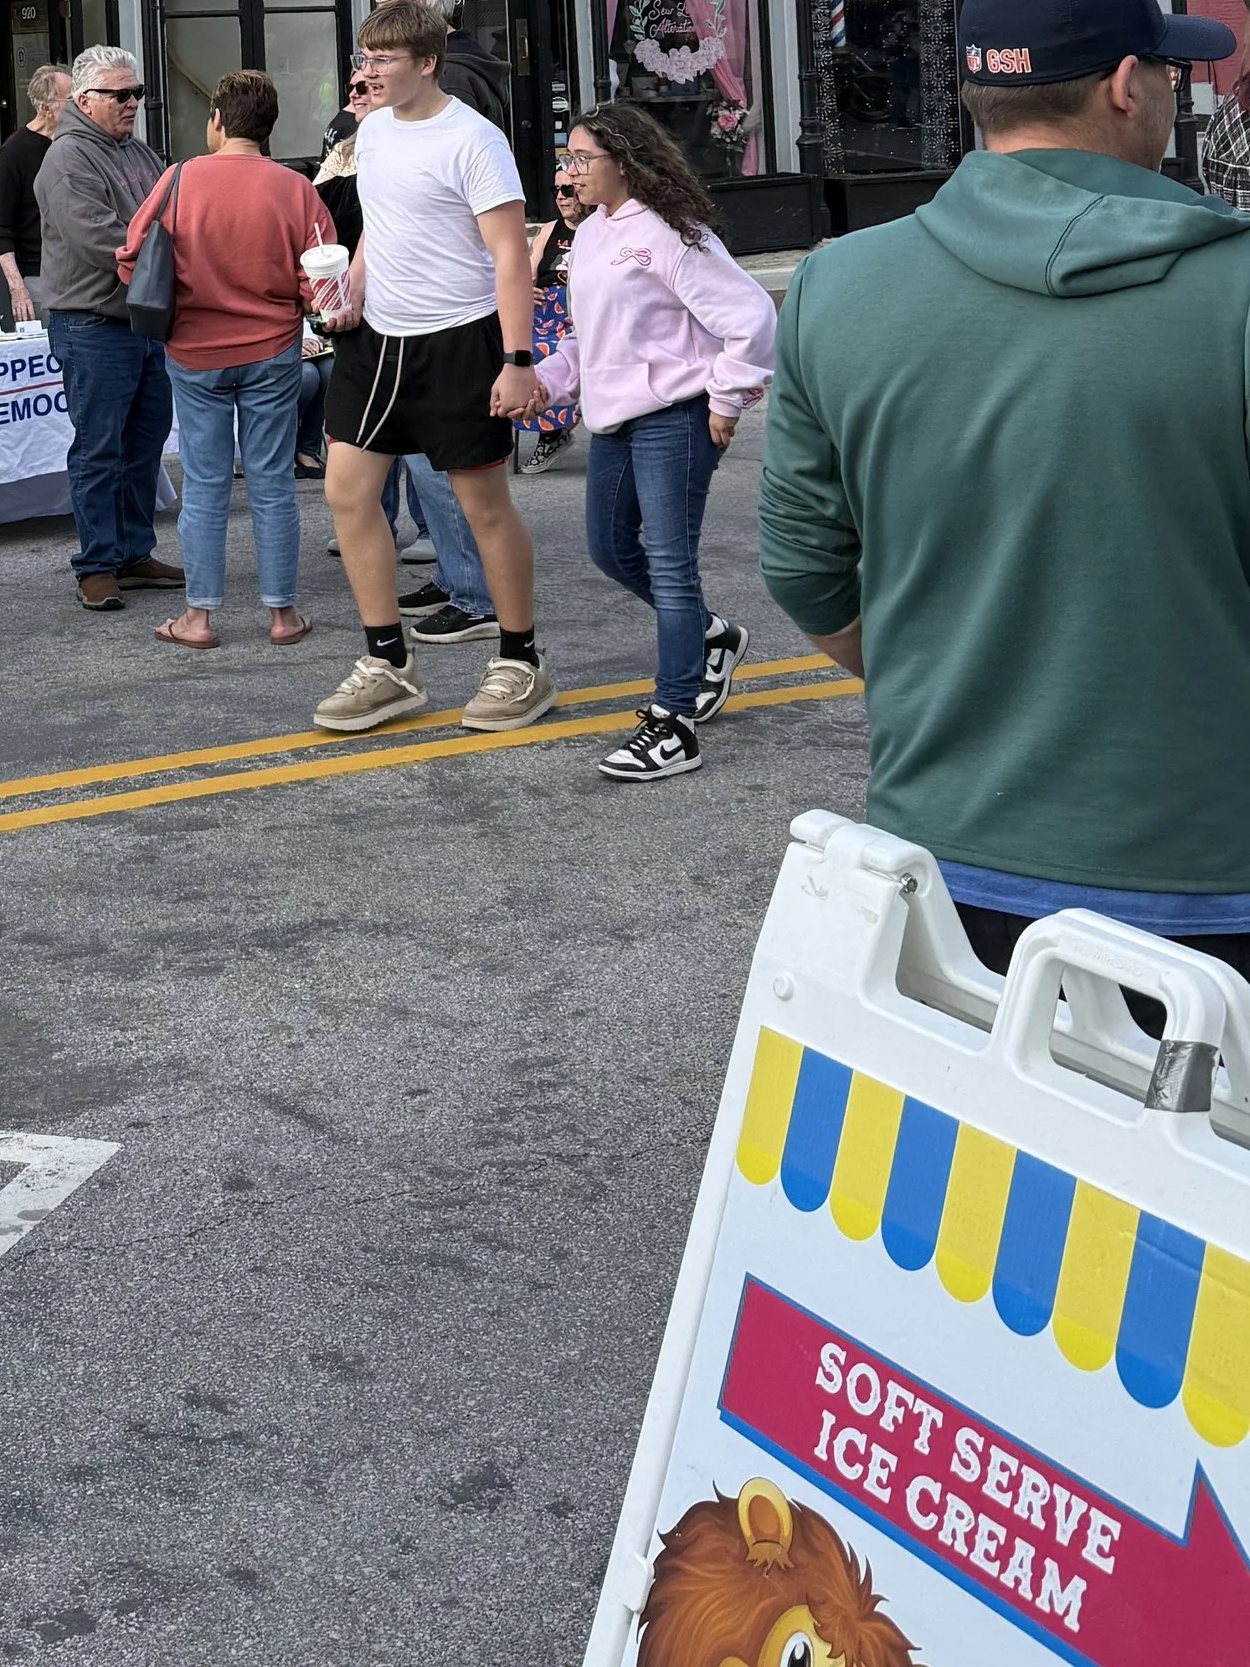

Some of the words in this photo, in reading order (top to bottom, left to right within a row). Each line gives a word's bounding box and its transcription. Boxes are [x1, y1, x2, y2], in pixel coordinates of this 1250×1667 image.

[21, 6, 37, 20] 920
[986, 48, 1032, 74] GSH
[815, 1342, 943, 1455] SOFT
[950, 1427, 1122, 1575] SERVE
[813, 1409, 898, 1504] ICE
[906, 1475, 1087, 1634] CREAM
